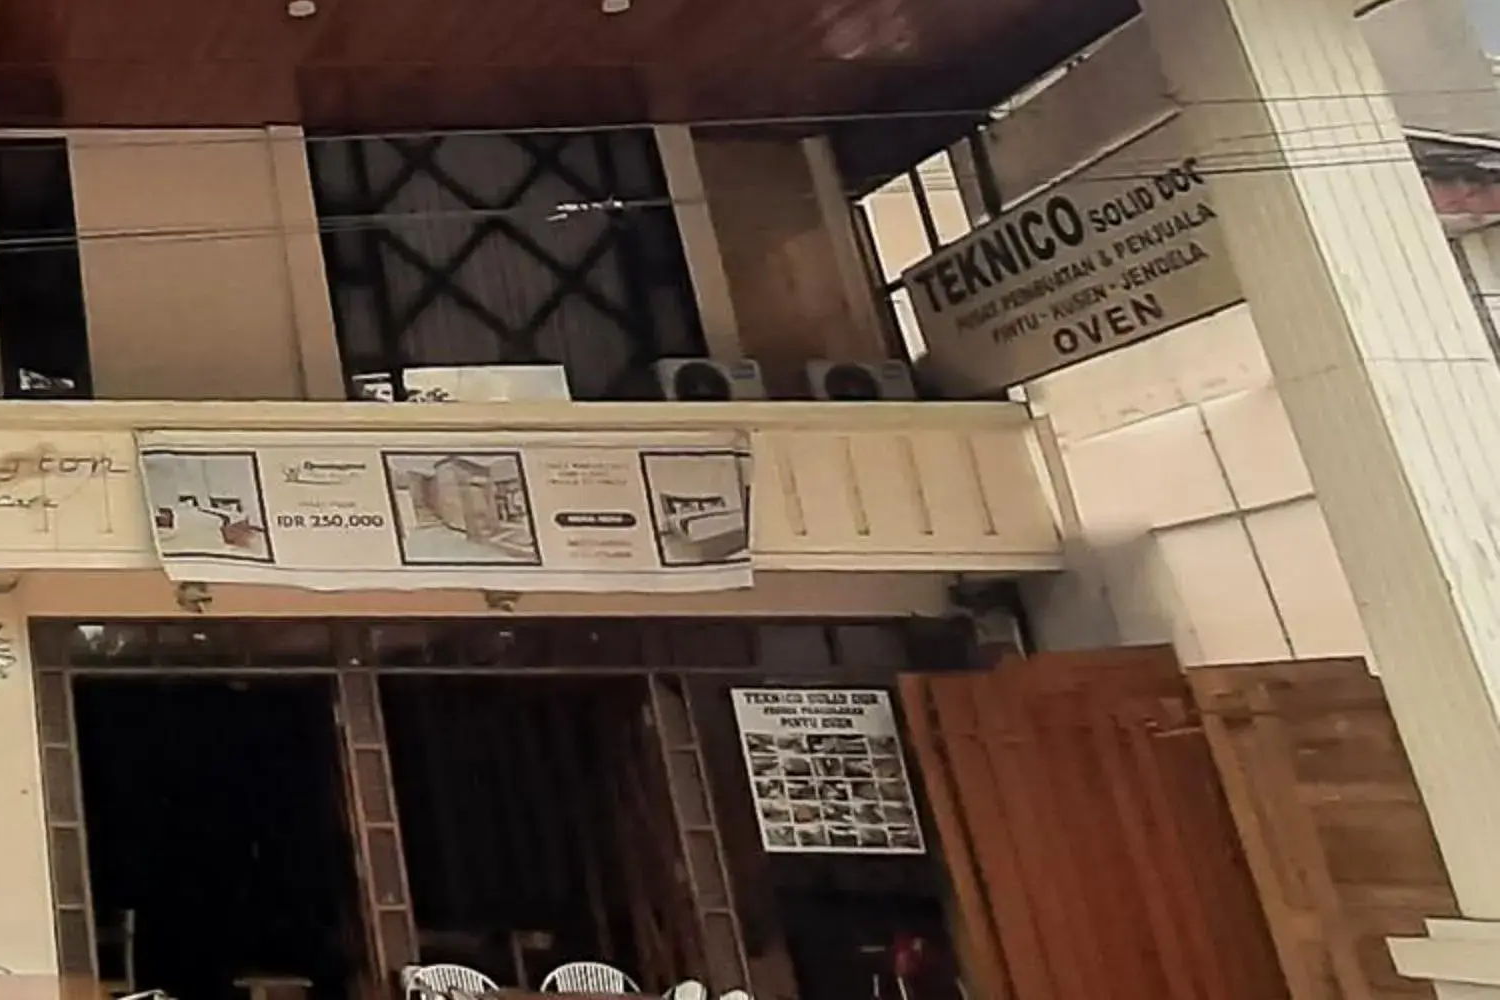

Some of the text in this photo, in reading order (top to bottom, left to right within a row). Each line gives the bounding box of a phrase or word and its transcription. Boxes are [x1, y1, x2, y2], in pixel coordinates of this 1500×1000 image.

[913, 194, 1086, 313] TEKNICO
[1087, 185, 1155, 233] SOLID
[1120, 241, 1211, 291] JENDELA
[1052, 292, 1167, 356] OVEN
[277, 514, 385, 530] IDR 250,000
